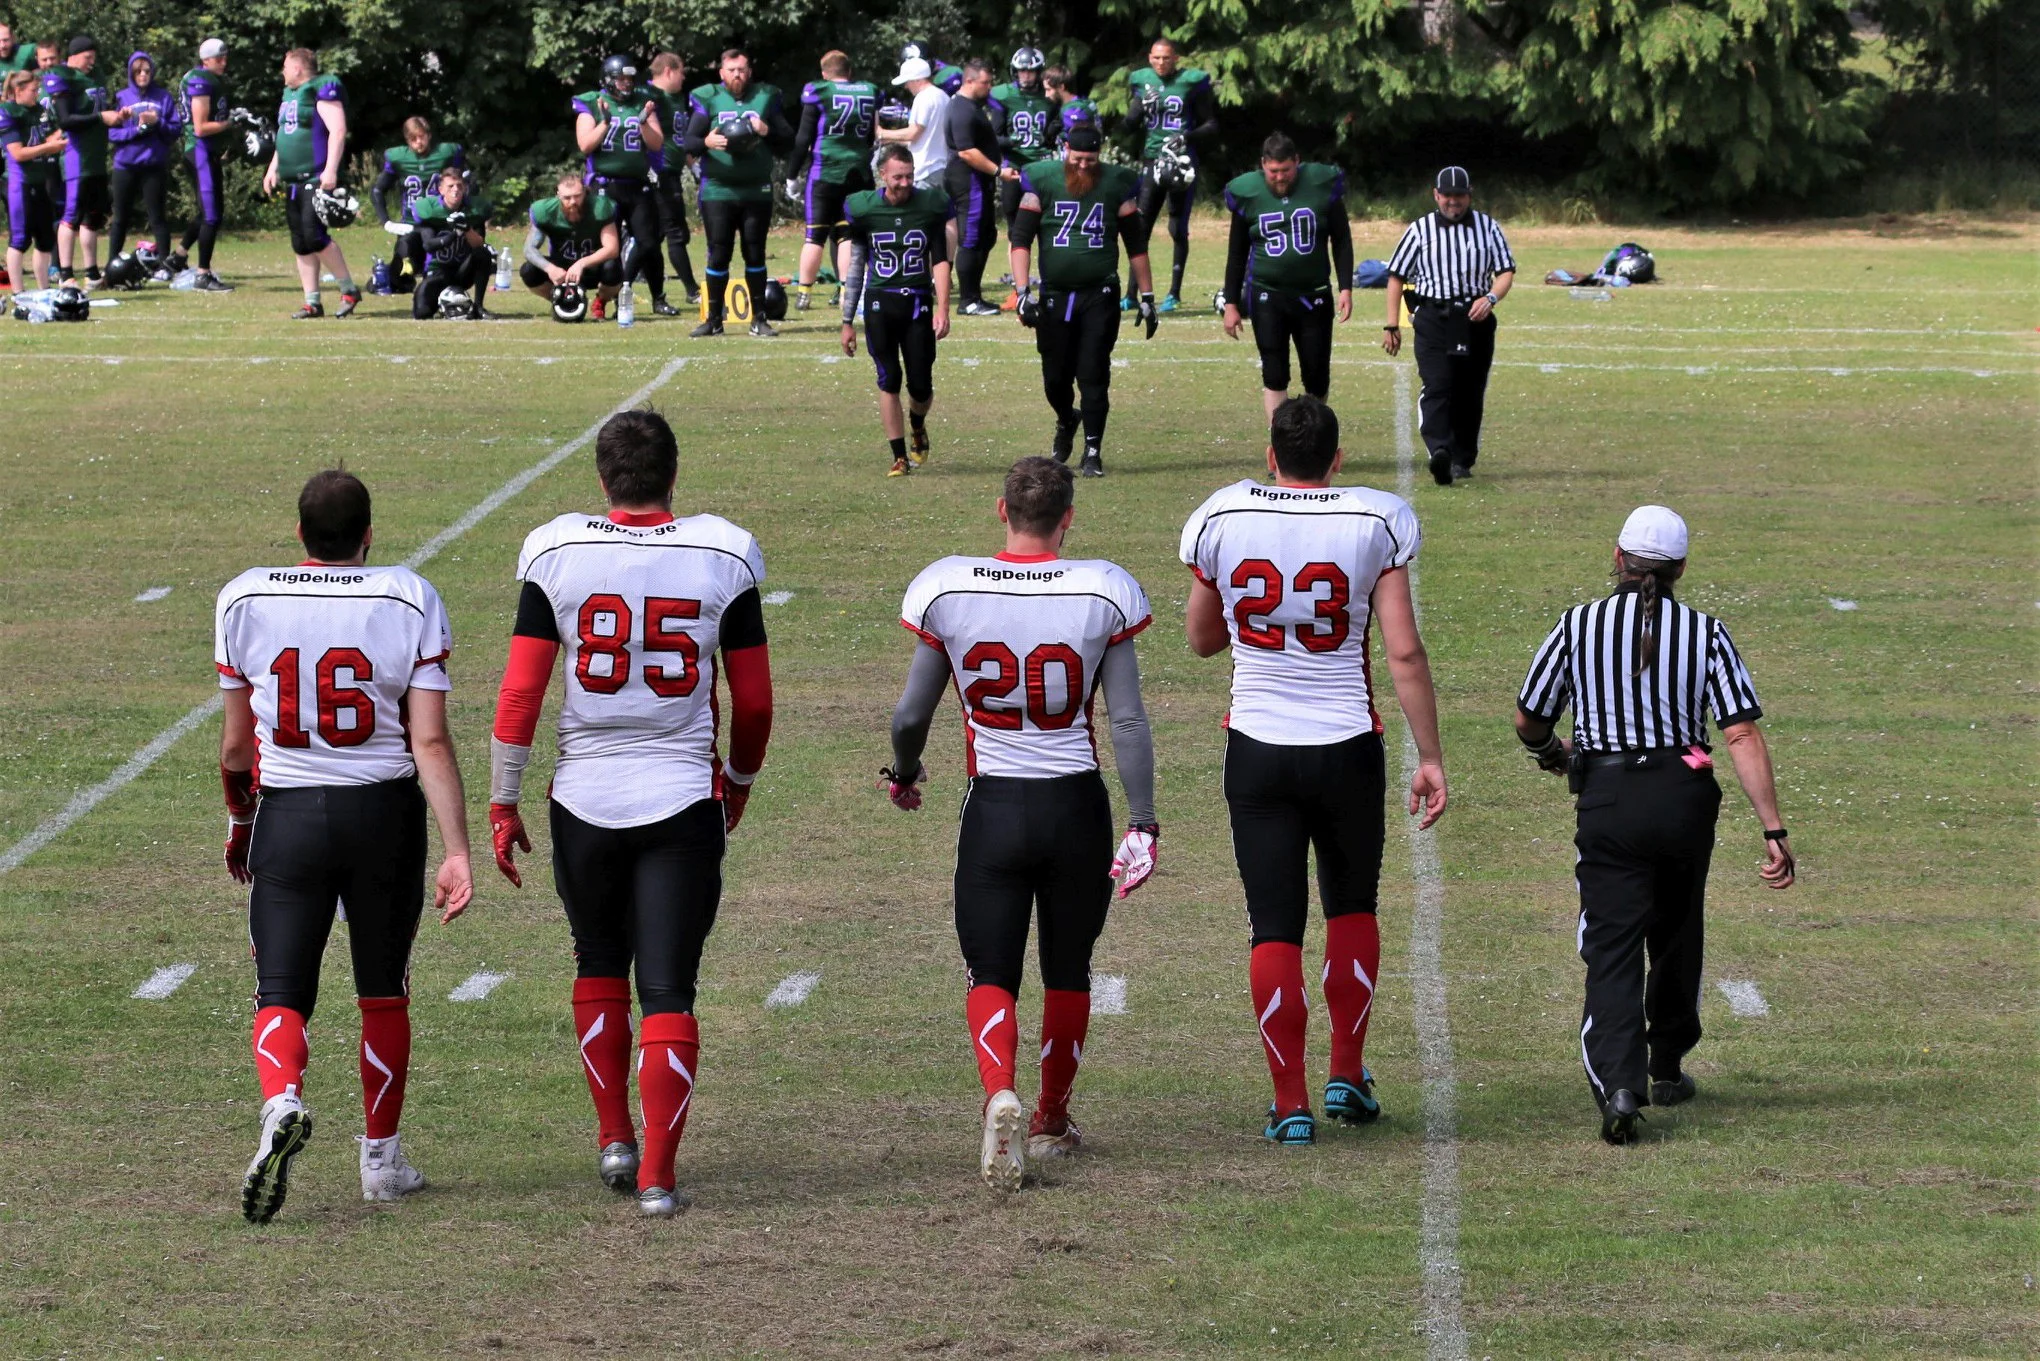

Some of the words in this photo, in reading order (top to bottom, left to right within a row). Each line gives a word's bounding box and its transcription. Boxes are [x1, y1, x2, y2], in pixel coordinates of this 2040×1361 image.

[602, 115, 640, 152] 72
[829, 94, 875, 138] 75
[1013, 111, 1046, 148] 81
[1053, 201, 1105, 248] 74
[1259, 207, 1317, 257] 50
[872, 229, 928, 278] 52
[1250, 487, 1341, 503] RigDeluge
[587, 520, 677, 538] Rigge
[268, 572, 364, 585] RigDeluge
[973, 567, 1064, 583] RigDeluge
[1230, 558, 1350, 653] 23
[575, 593, 702, 698] 85
[269, 646, 376, 749] 16
[962, 641, 1084, 731] 20
[1324, 1089, 1349, 1103] NIKE
[1286, 1124, 1312, 1138] NIKE
